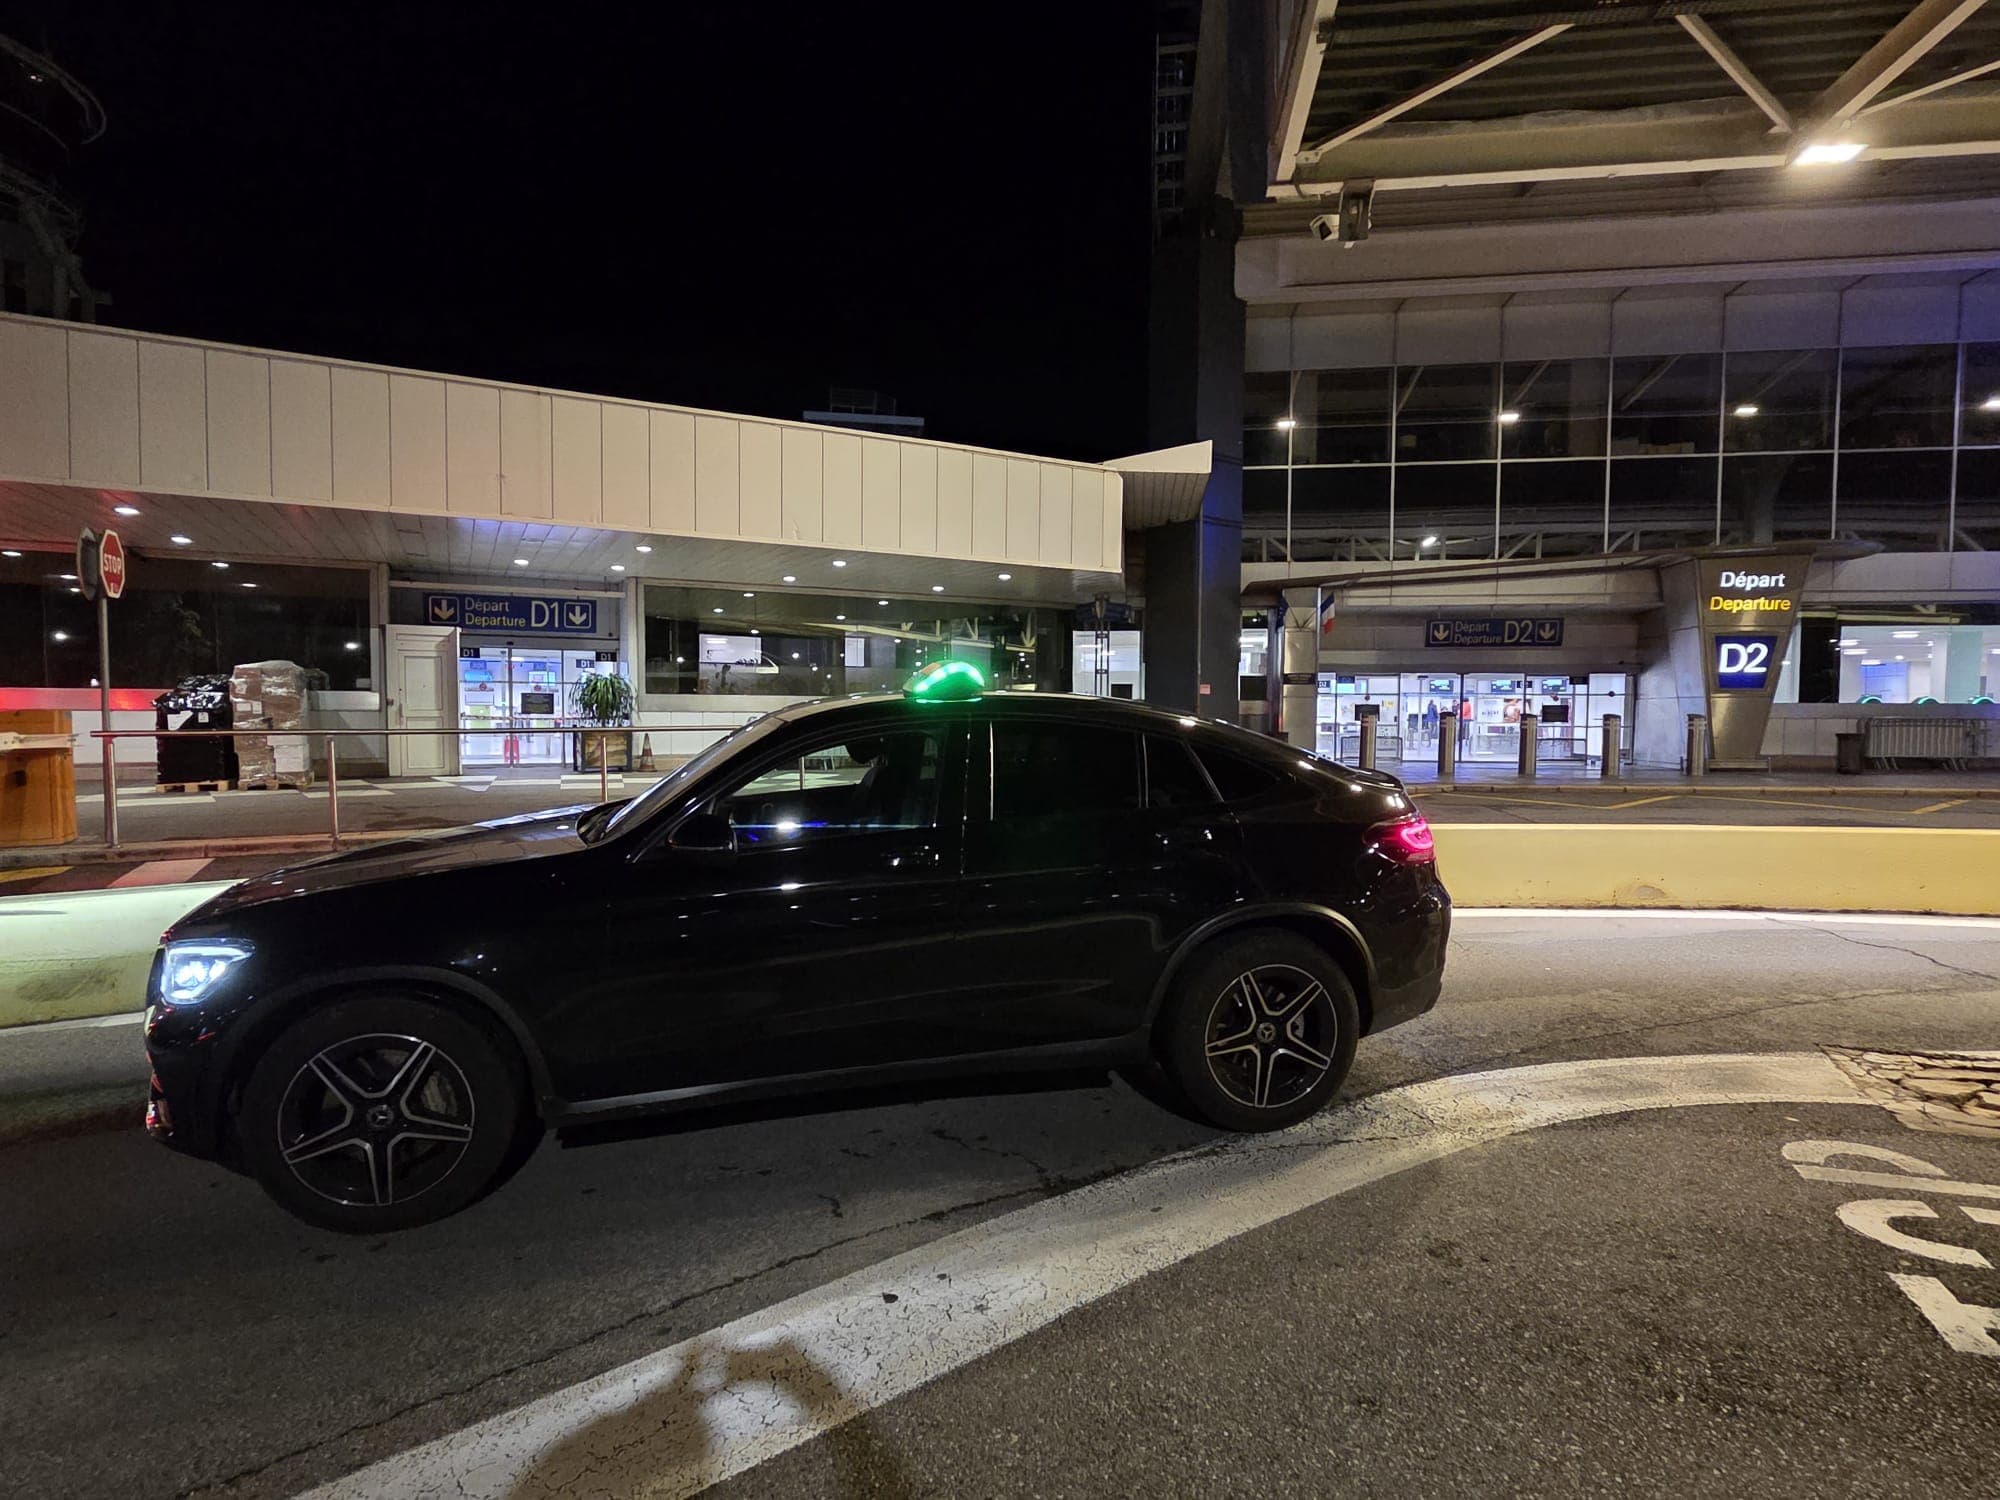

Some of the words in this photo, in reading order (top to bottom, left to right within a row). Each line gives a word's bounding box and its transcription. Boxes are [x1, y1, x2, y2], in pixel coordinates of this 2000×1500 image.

[104, 553, 122, 575] STOP
[1720, 571, 1786, 591] Départ
[464, 597, 510, 613] Départ
[1710, 596, 1792, 613] Departure
[465, 612, 526, 628] Departure
[530, 600, 559, 628] D1
[1455, 620, 1490, 633] Départ
[1503, 620, 1533, 643] D2
[1455, 633, 1502, 645] Departure
[463, 648, 475, 657] D1
[600, 652, 612, 661] D1
[1718, 642, 1769, 673] D2
